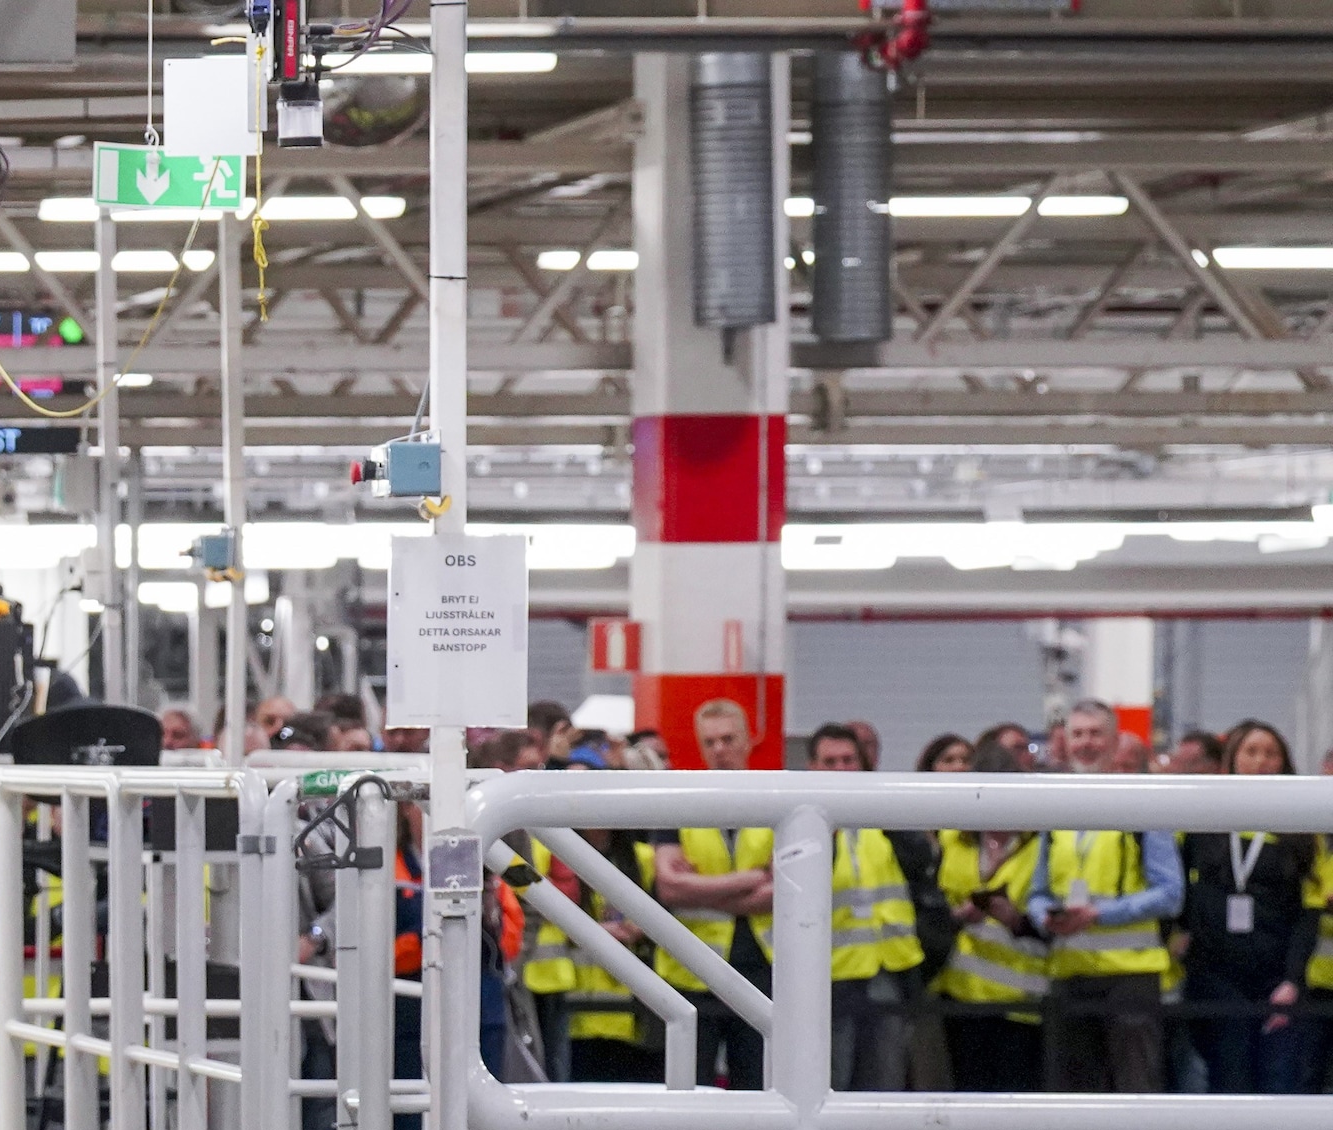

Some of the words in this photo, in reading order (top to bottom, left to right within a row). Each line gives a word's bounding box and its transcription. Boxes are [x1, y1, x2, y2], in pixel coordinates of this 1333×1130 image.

[445, 554, 477, 567] OBS
[441, 595, 466, 604] BRYT
[469, 595, 479, 604] EJ
[425, 609, 495, 619] LJUSSTRÅLEN
[419, 628, 450, 636] DETTA
[452, 628, 501, 636] ORSAKAR
[433, 643, 487, 652] BANSTOPP
